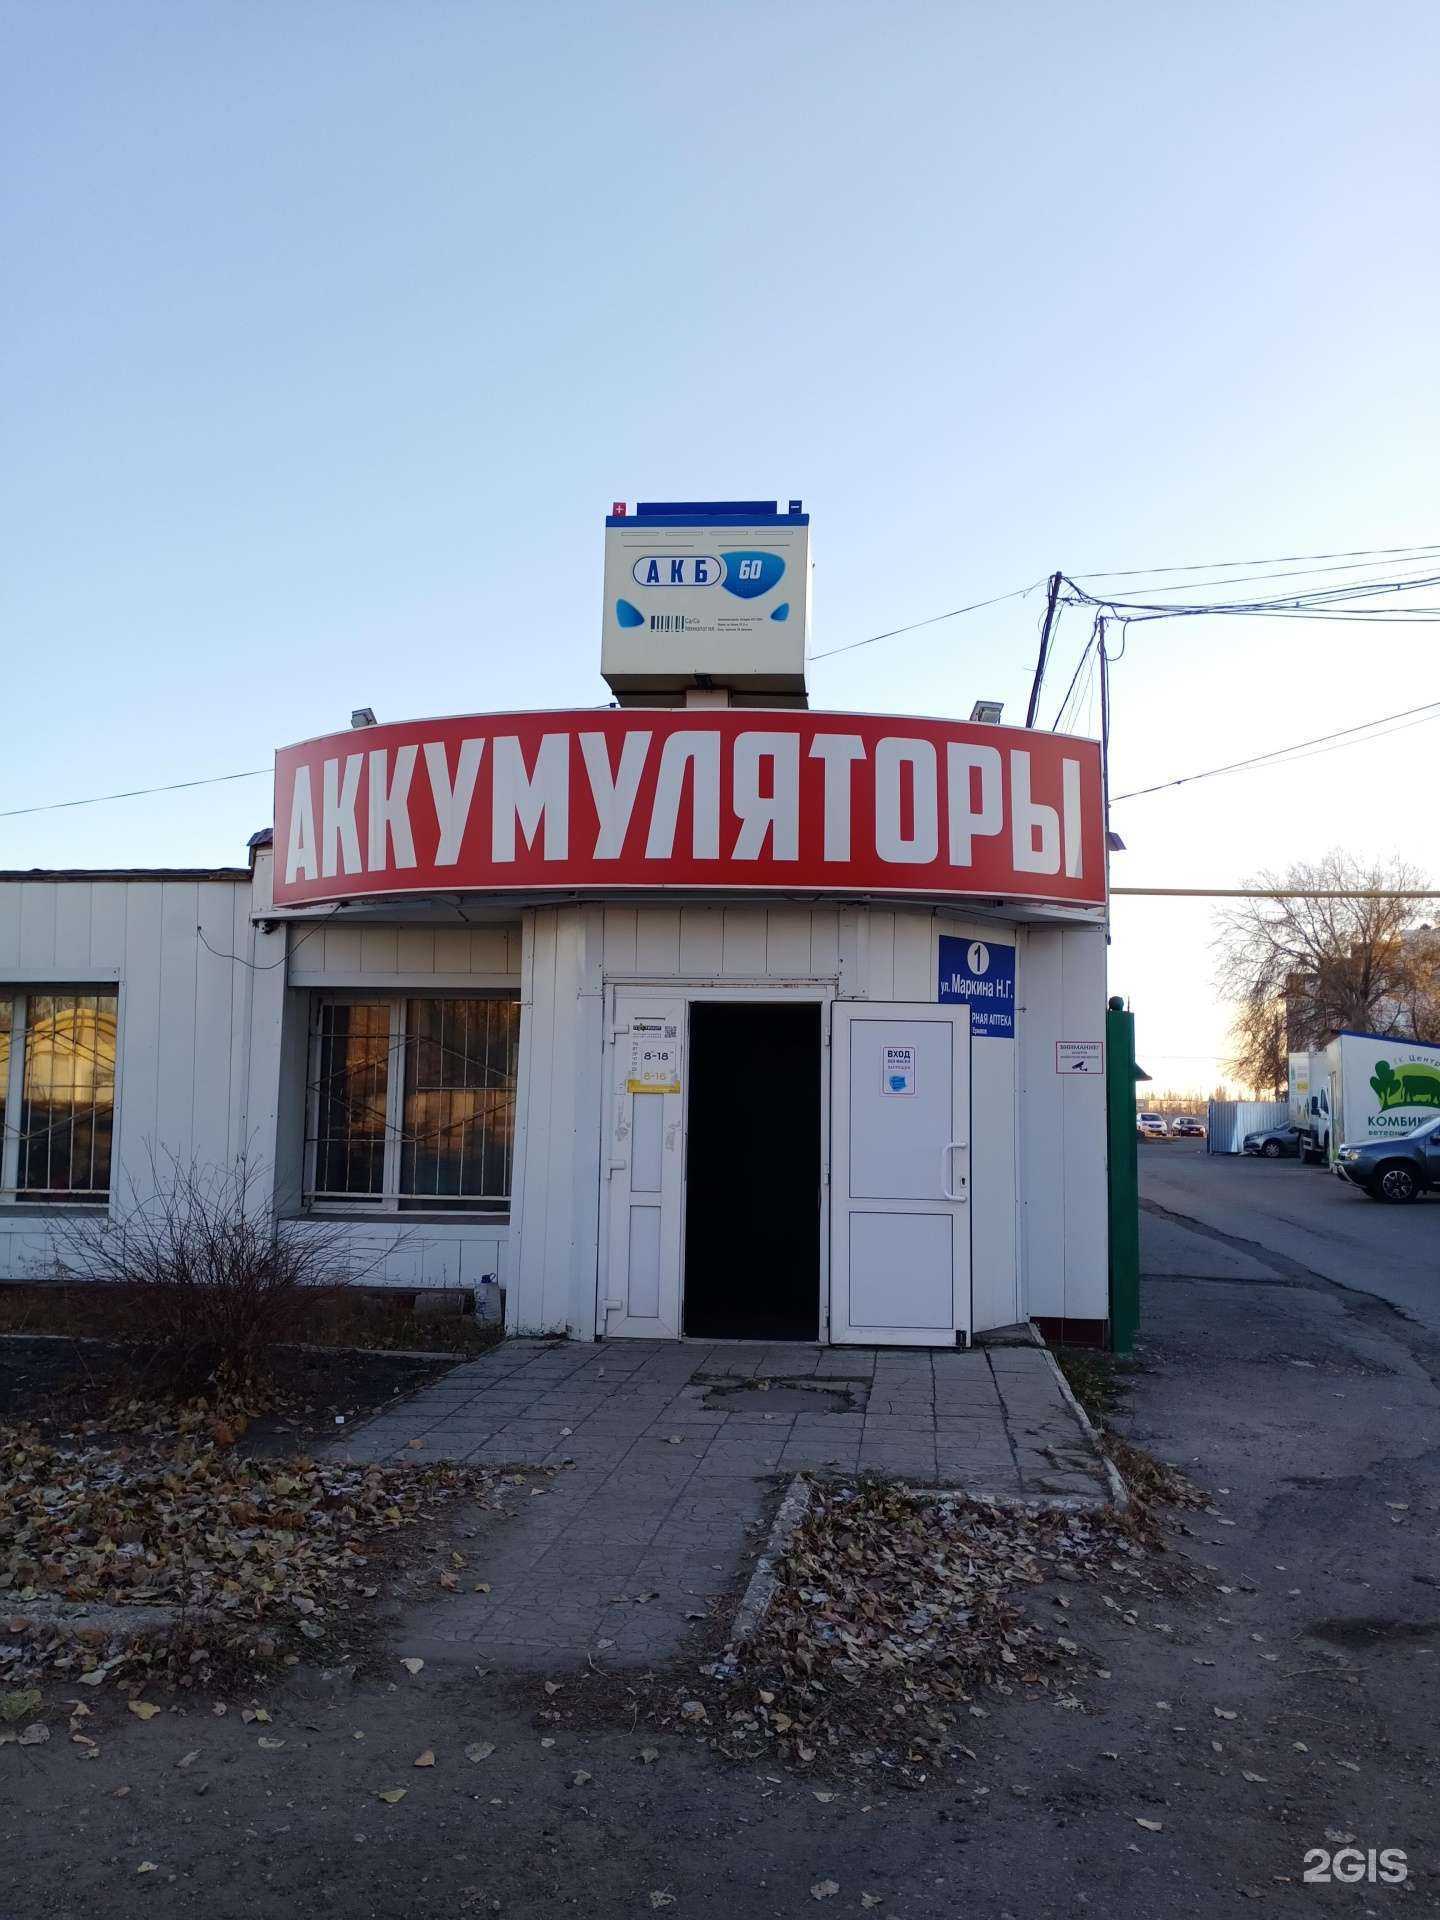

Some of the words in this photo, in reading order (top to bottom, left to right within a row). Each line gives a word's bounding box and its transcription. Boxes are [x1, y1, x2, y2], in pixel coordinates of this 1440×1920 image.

[739, 559, 761, 580] 60
[284, 730, 1083, 880] АККУМУЛЯТОРЫ
[974, 944, 981, 972] 1
[941, 981, 950, 995] ул.
[951, 973, 994, 999] Маркина
[989, 1013, 1012, 1027] АПТЕКА
[887, 1050, 911, 1059] ВХОД
